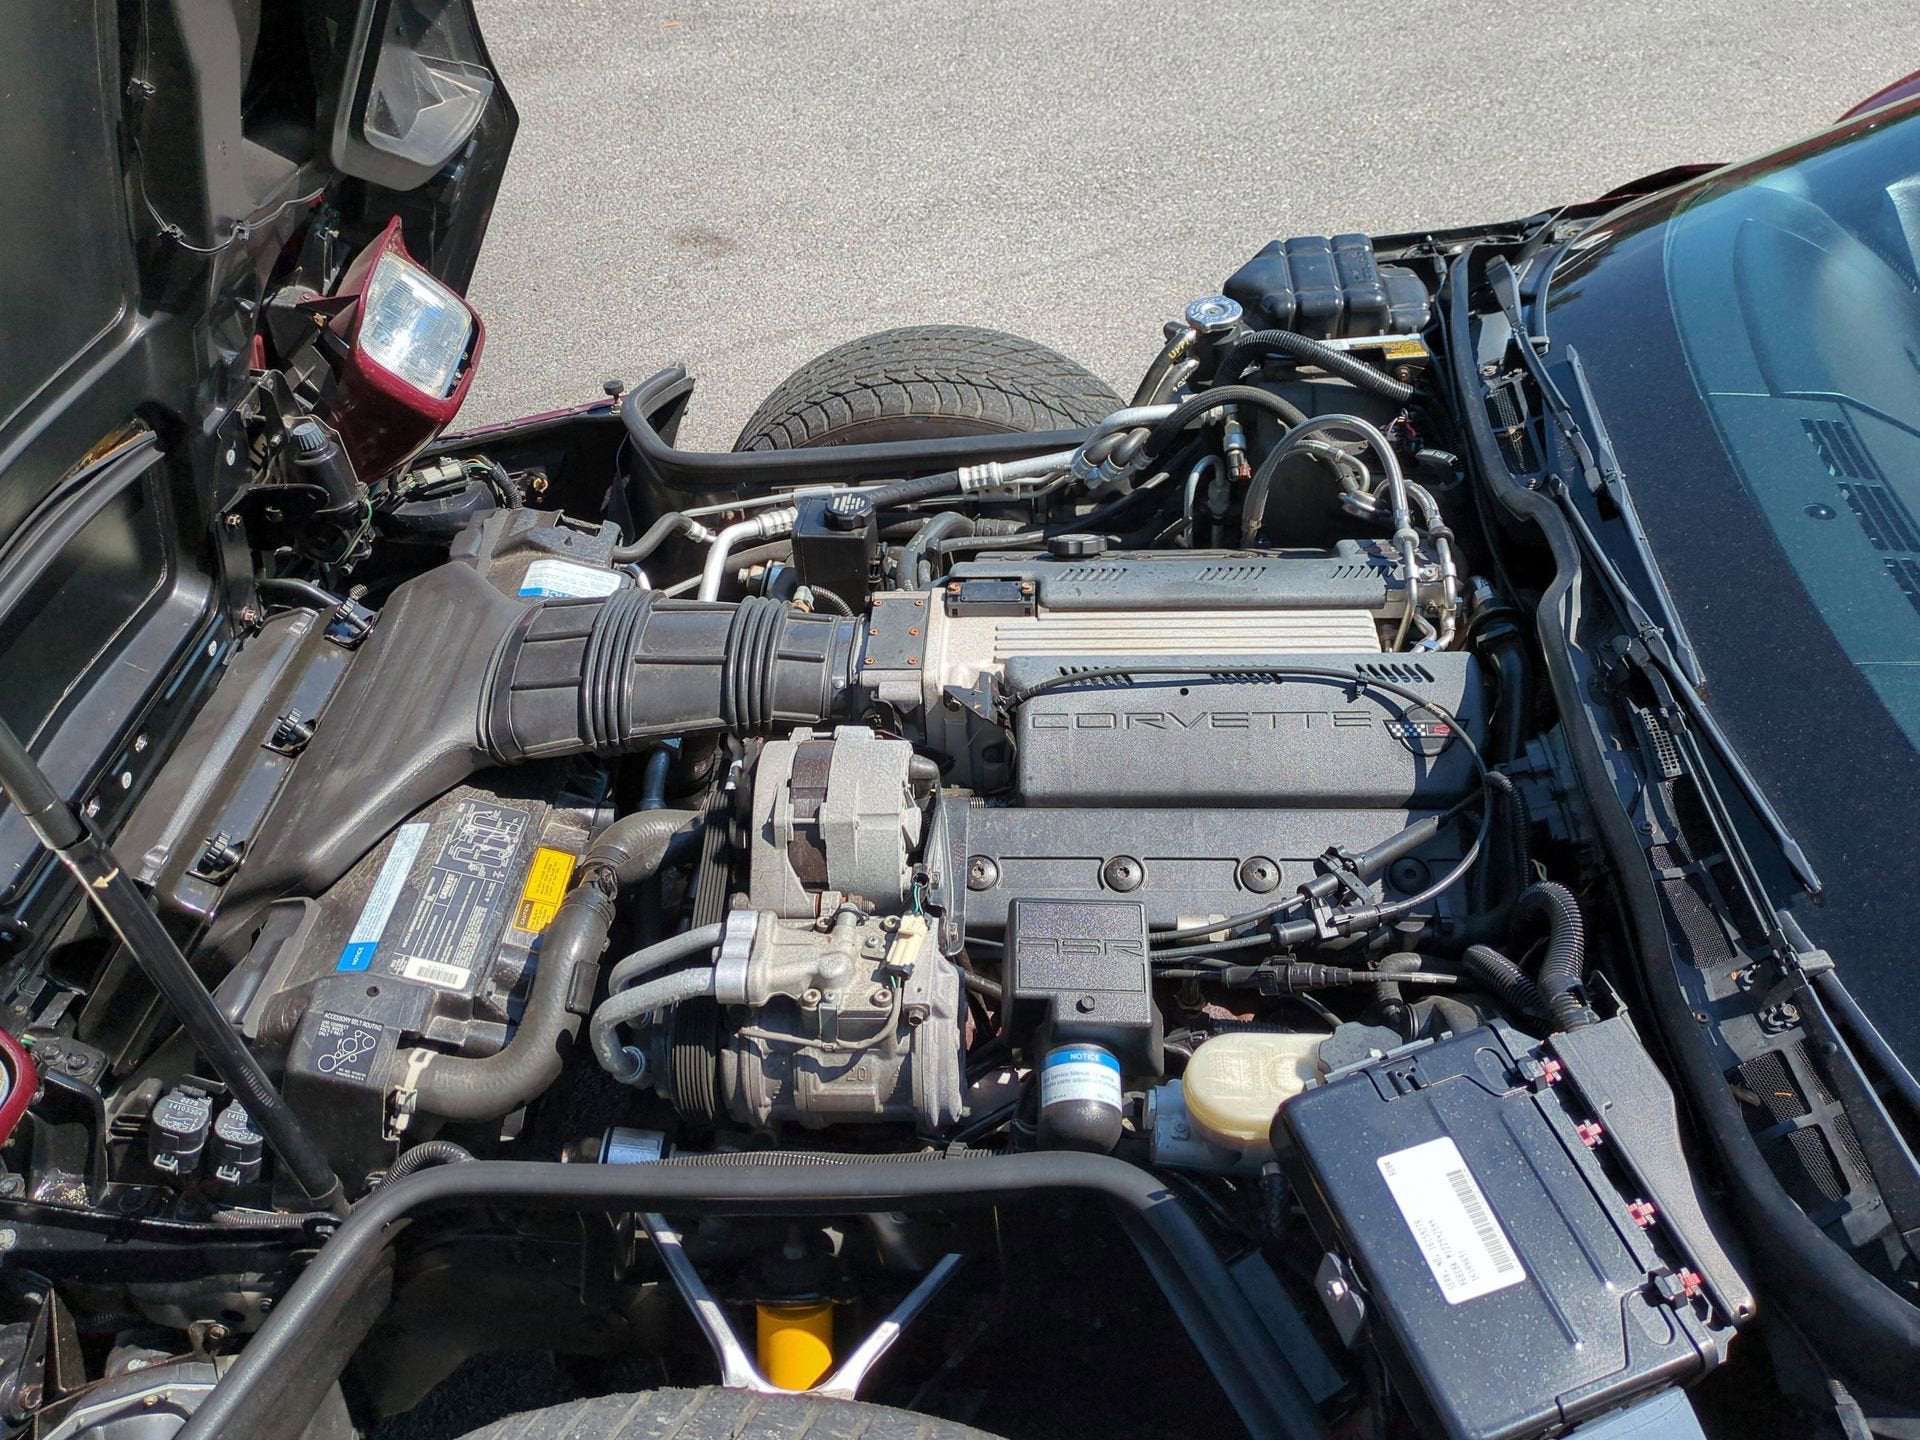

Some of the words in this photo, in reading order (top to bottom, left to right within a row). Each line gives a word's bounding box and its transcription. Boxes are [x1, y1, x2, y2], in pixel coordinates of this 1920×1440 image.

[1029, 710, 1371, 730] CORVETTE
[519, 903, 530, 926] CAUTION
[1017, 937, 1143, 956] ASR
[352, 946, 364, 966] NOTICE
[324, 1012, 351, 1024] ACCESSORY
[351, 1018, 362, 1026] BELT
[362, 1020, 383, 1031] ROUTING
[1070, 1053, 1100, 1061] NOTICE
[847, 1067, 866, 1082] 20
[168, 1103, 203, 1116] 14103304
[180, 1097, 199, 1106] 2279
[227, 1112, 248, 1122] 14103
